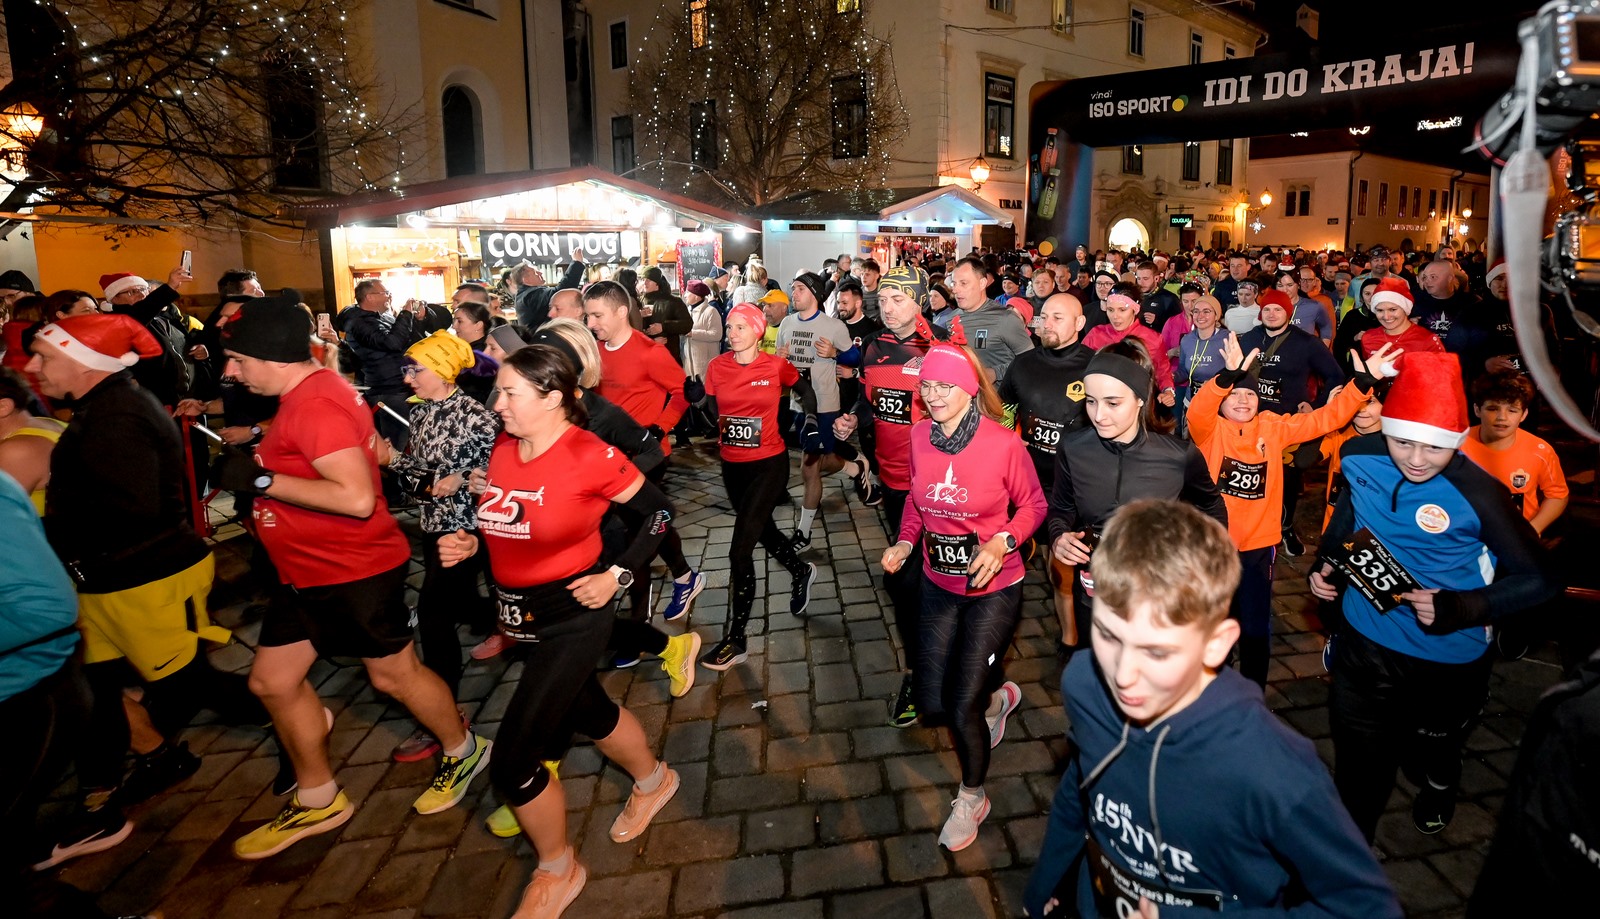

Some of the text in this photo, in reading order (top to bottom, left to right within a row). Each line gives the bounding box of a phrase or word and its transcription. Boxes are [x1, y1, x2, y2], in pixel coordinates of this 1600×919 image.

[1203, 42, 1474, 107] IDI DO KRAJA!
[1089, 95, 1172, 118] ISO SPORT
[998, 199, 1022, 209] URAR
[487, 232, 617, 258] CORN DOG
[792, 331, 814, 339] TONIGHT
[879, 397, 903, 415] 352
[728, 425, 752, 440] 330
[1034, 426, 1060, 445] 349
[1228, 470, 1260, 490] 289
[477, 484, 538, 525] 25
[942, 508, 962, 517] Year's
[935, 544, 969, 564] 184
[1349, 549, 1398, 591] 335
[1119, 815, 1200, 873] NYR
[1131, 881, 1164, 903] Year's
